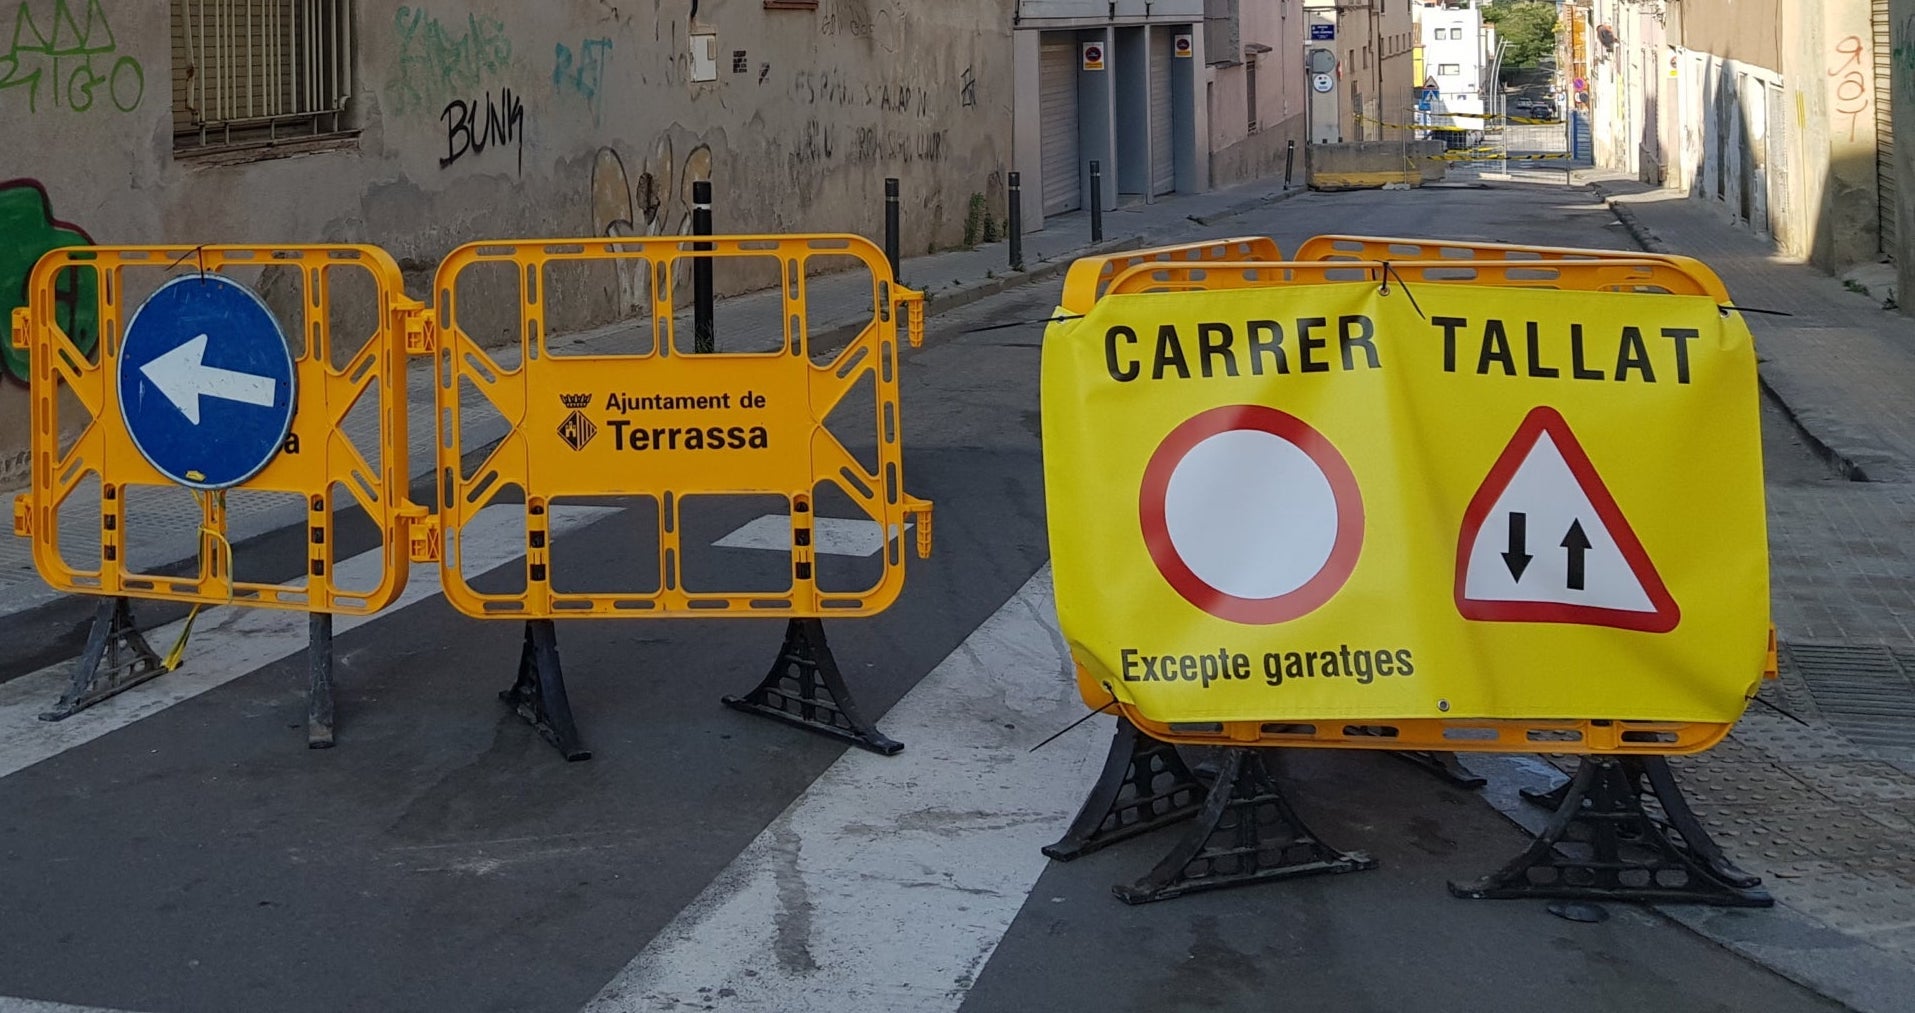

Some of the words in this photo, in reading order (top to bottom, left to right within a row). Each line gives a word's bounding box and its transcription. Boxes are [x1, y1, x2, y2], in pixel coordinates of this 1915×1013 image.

[1104, 314, 1383, 383] CARRER
[1431, 316, 1700, 384] TALLAT
[605, 392, 731, 414] Ajuntament
[739, 390, 767, 409] de
[606, 419, 769, 451] Terrassa
[1120, 647, 1251, 688] Excepte
[1263, 644, 1415, 686] garatges
